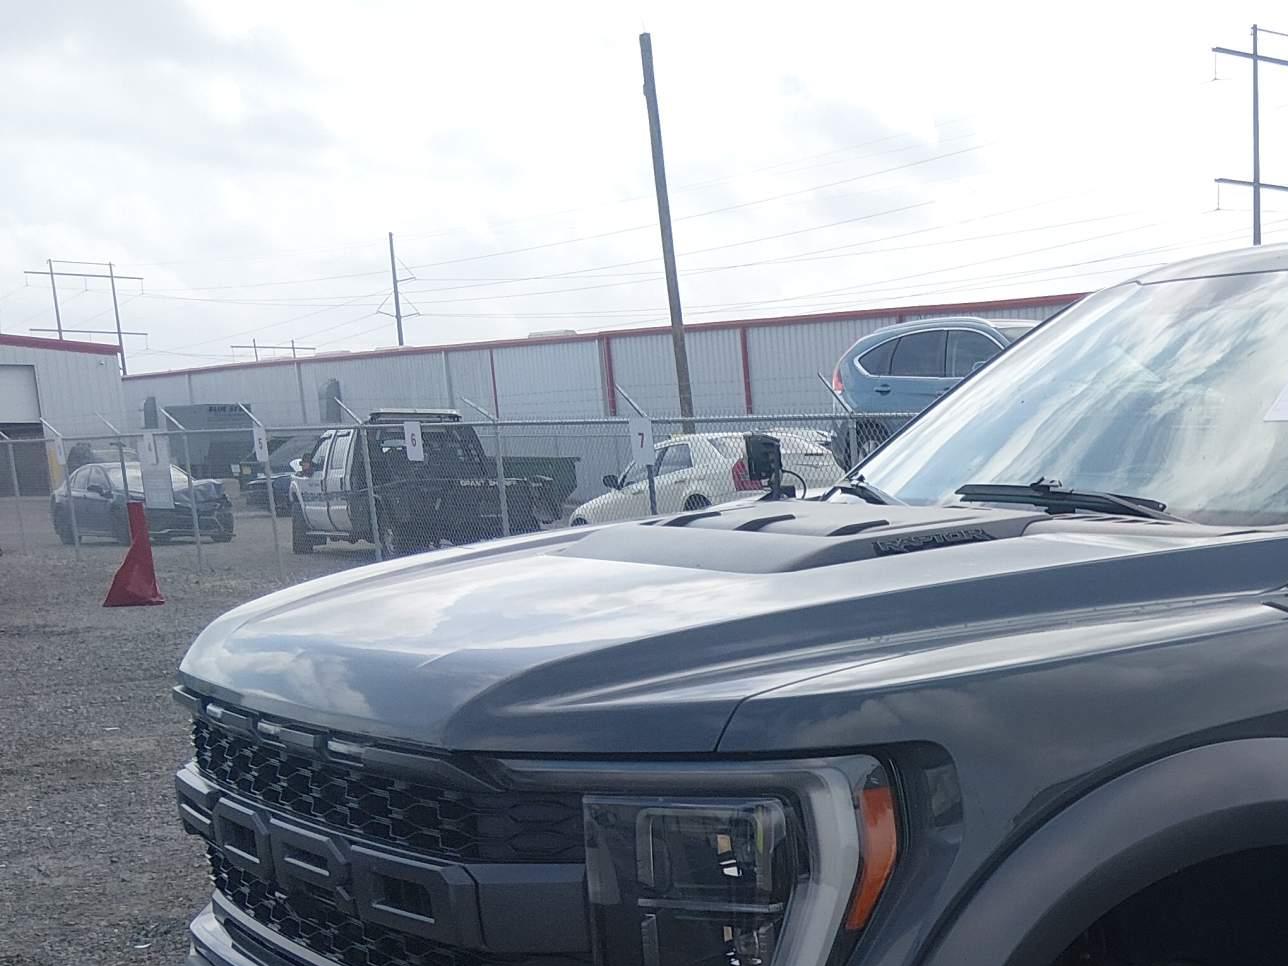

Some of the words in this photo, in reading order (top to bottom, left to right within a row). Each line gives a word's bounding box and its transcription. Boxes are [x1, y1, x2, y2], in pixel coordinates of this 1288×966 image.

[410, 432, 417, 448] 6
[638, 432, 645, 449] 7
[873, 528, 994, 554] RAPTOR
